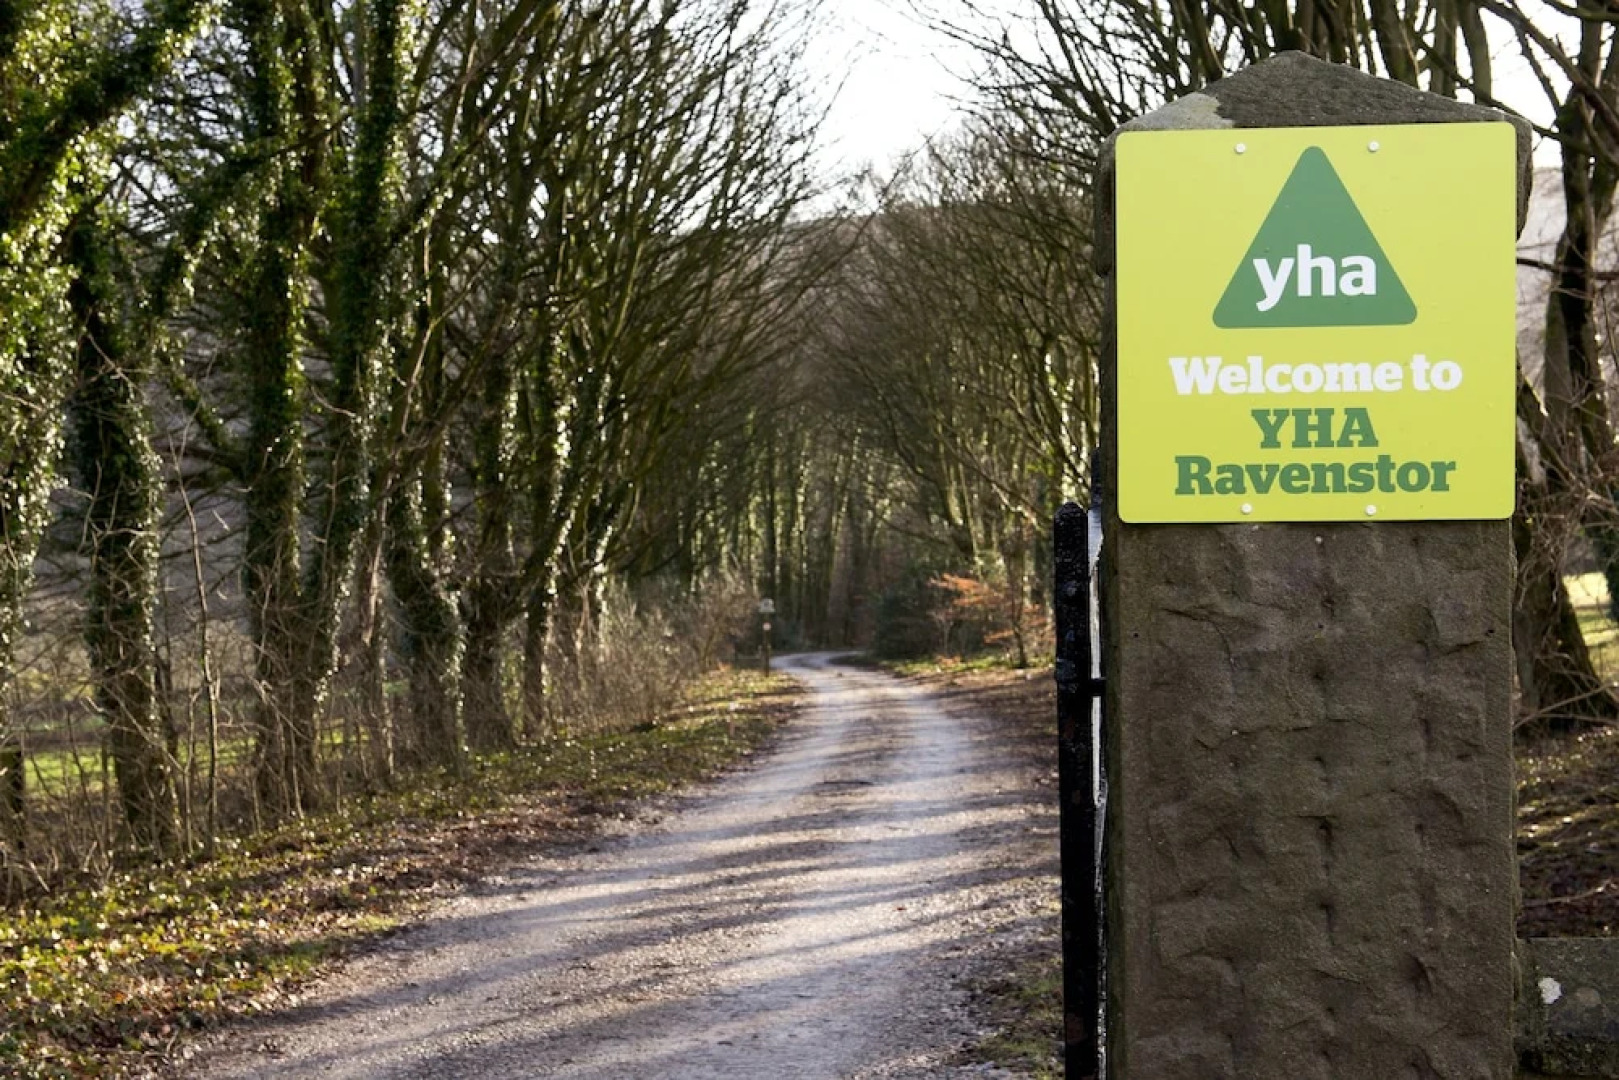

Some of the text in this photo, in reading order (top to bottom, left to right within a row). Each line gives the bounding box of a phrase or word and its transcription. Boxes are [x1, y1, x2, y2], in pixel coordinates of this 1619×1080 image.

[1253, 244, 1377, 312] yha
[1169, 354, 1463, 395] Welcome to
[1251, 407, 1379, 449] YHA
[1174, 454, 1456, 495] Ravenstor
